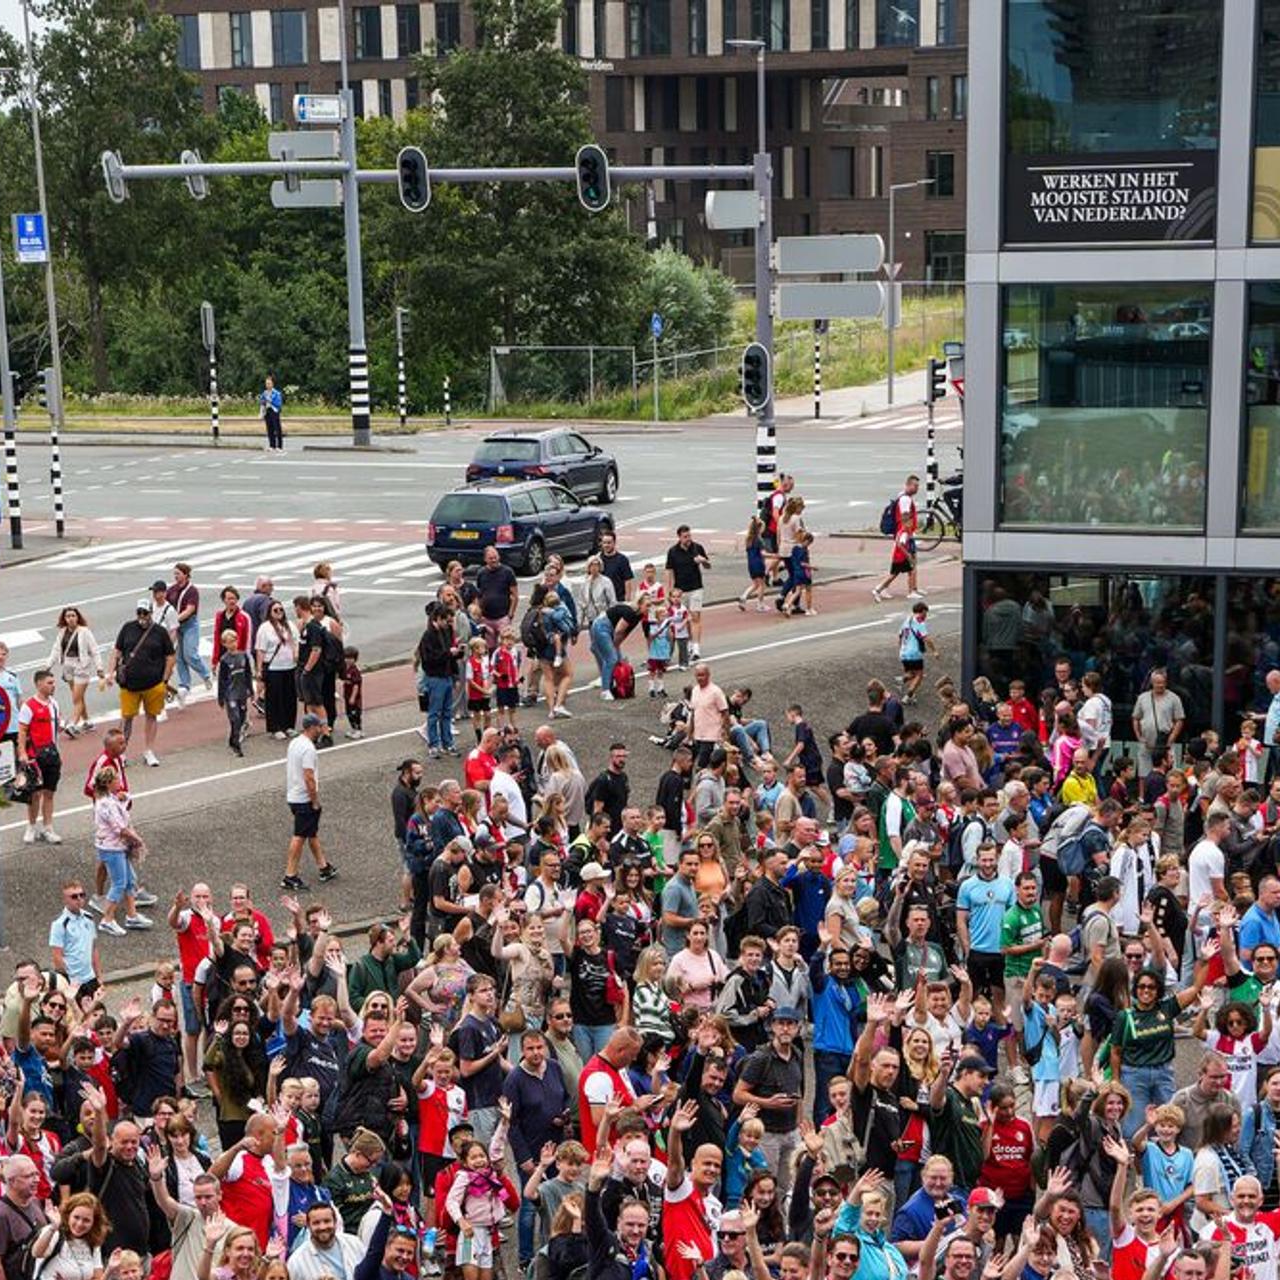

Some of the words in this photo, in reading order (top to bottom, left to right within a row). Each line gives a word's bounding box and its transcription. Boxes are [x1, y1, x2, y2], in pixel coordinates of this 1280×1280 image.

[1042, 172, 1116, 190] WERKEN
[1120, 172, 1140, 188] IN
[1143, 171, 1179, 188] HET
[1030, 190, 1109, 207] MOOISTE
[1111, 188, 1190, 204] STADION
[1033, 207, 1069, 223] VAN
[1072, 205, 1187, 222] NEDERLAND?
